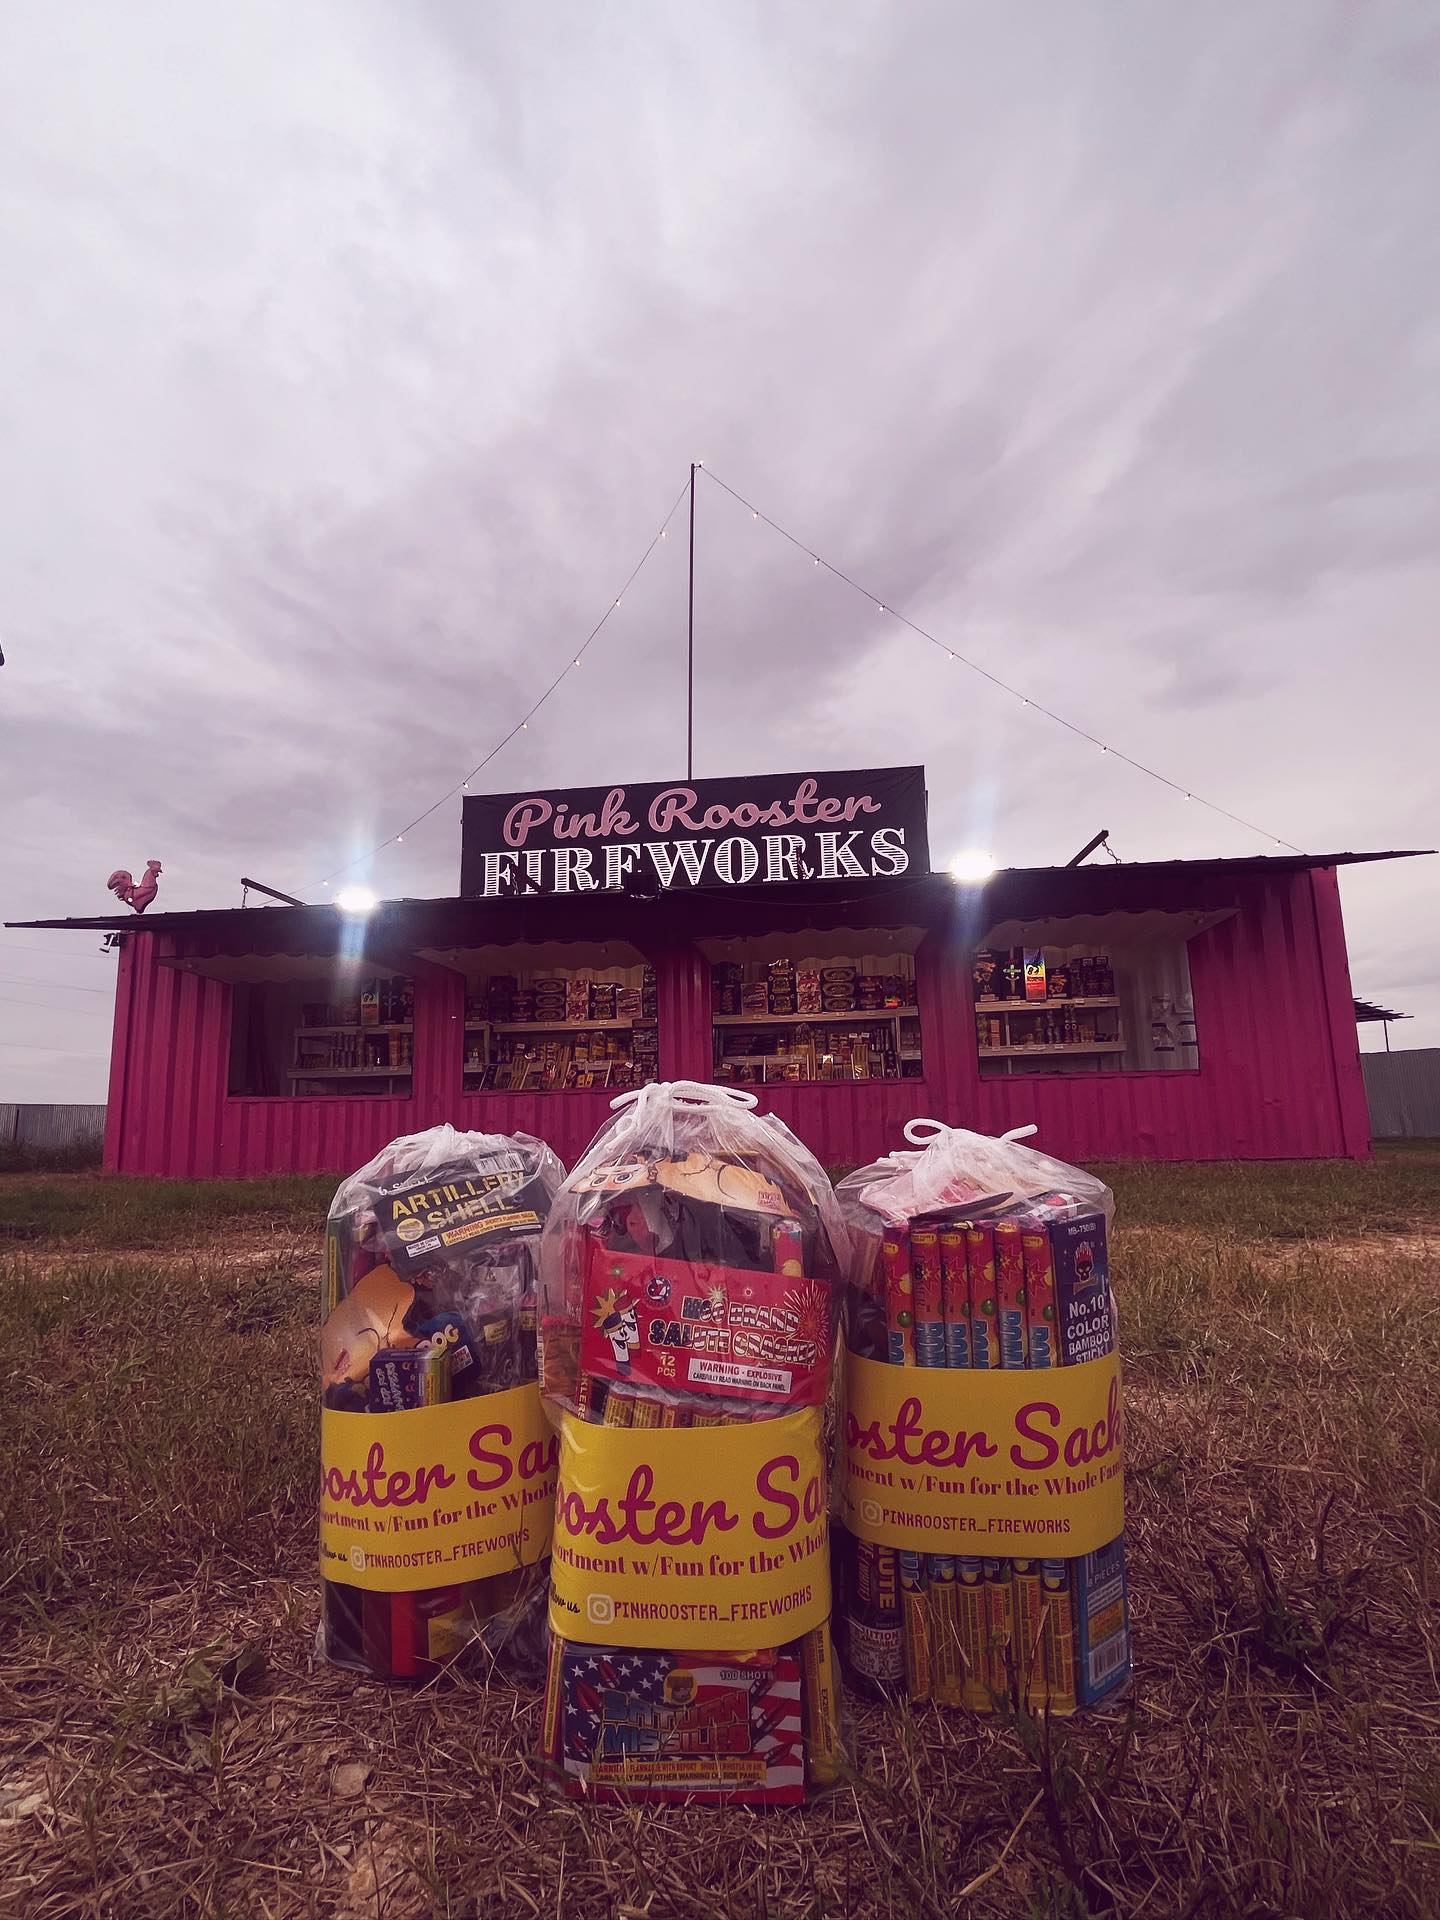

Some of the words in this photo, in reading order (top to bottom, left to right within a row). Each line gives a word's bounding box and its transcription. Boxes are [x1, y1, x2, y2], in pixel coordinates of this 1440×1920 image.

[503, 788, 640, 847] Pink
[648, 778, 882, 834] Rooster
[479, 827, 910, 897] FIREWORKS
[392, 1171, 524, 1220] ARTILLERY
[427, 1193, 514, 1230] SHELL
[447, 1221, 484, 1239] WARNING
[728, 1302, 800, 1333] BRAND
[1067, 1314, 1110, 1340] COLOR
[648, 1318, 732, 1354] SALUTE
[1069, 1330, 1110, 1355] BAMBOO
[657, 1367, 676, 1378] PCS
[660, 1352, 675, 1367] 12
[700, 1361, 740, 1376] WARNING
[746, 1369, 783, 1382] EXPLOSIVE
[693, 1372, 718, 1383] CAREFULLY
[719, 1375, 732, 1384] READ
[760, 1381, 772, 1389] BACK
[772, 1384, 786, 1392] PANEL
[900, 1474, 965, 1496] w/Fun
[970, 1475, 1002, 1497] for
[1005, 1477, 1040, 1497] the
[1044, 1470, 1097, 1497] Whole
[322, 1510, 370, 1531] ortment
[374, 1515, 429, 1535] w/Fun
[432, 1507, 463, 1527] for
[466, 1500, 498, 1519] the
[555, 1542, 626, 1575] ortment
[632, 1554, 704, 1578] w/Fun
[709, 1554, 744, 1576] for
[749, 1551, 785, 1574] the
[566, 1601, 581, 1614] us
[720, 1670, 738, 1681] 100
